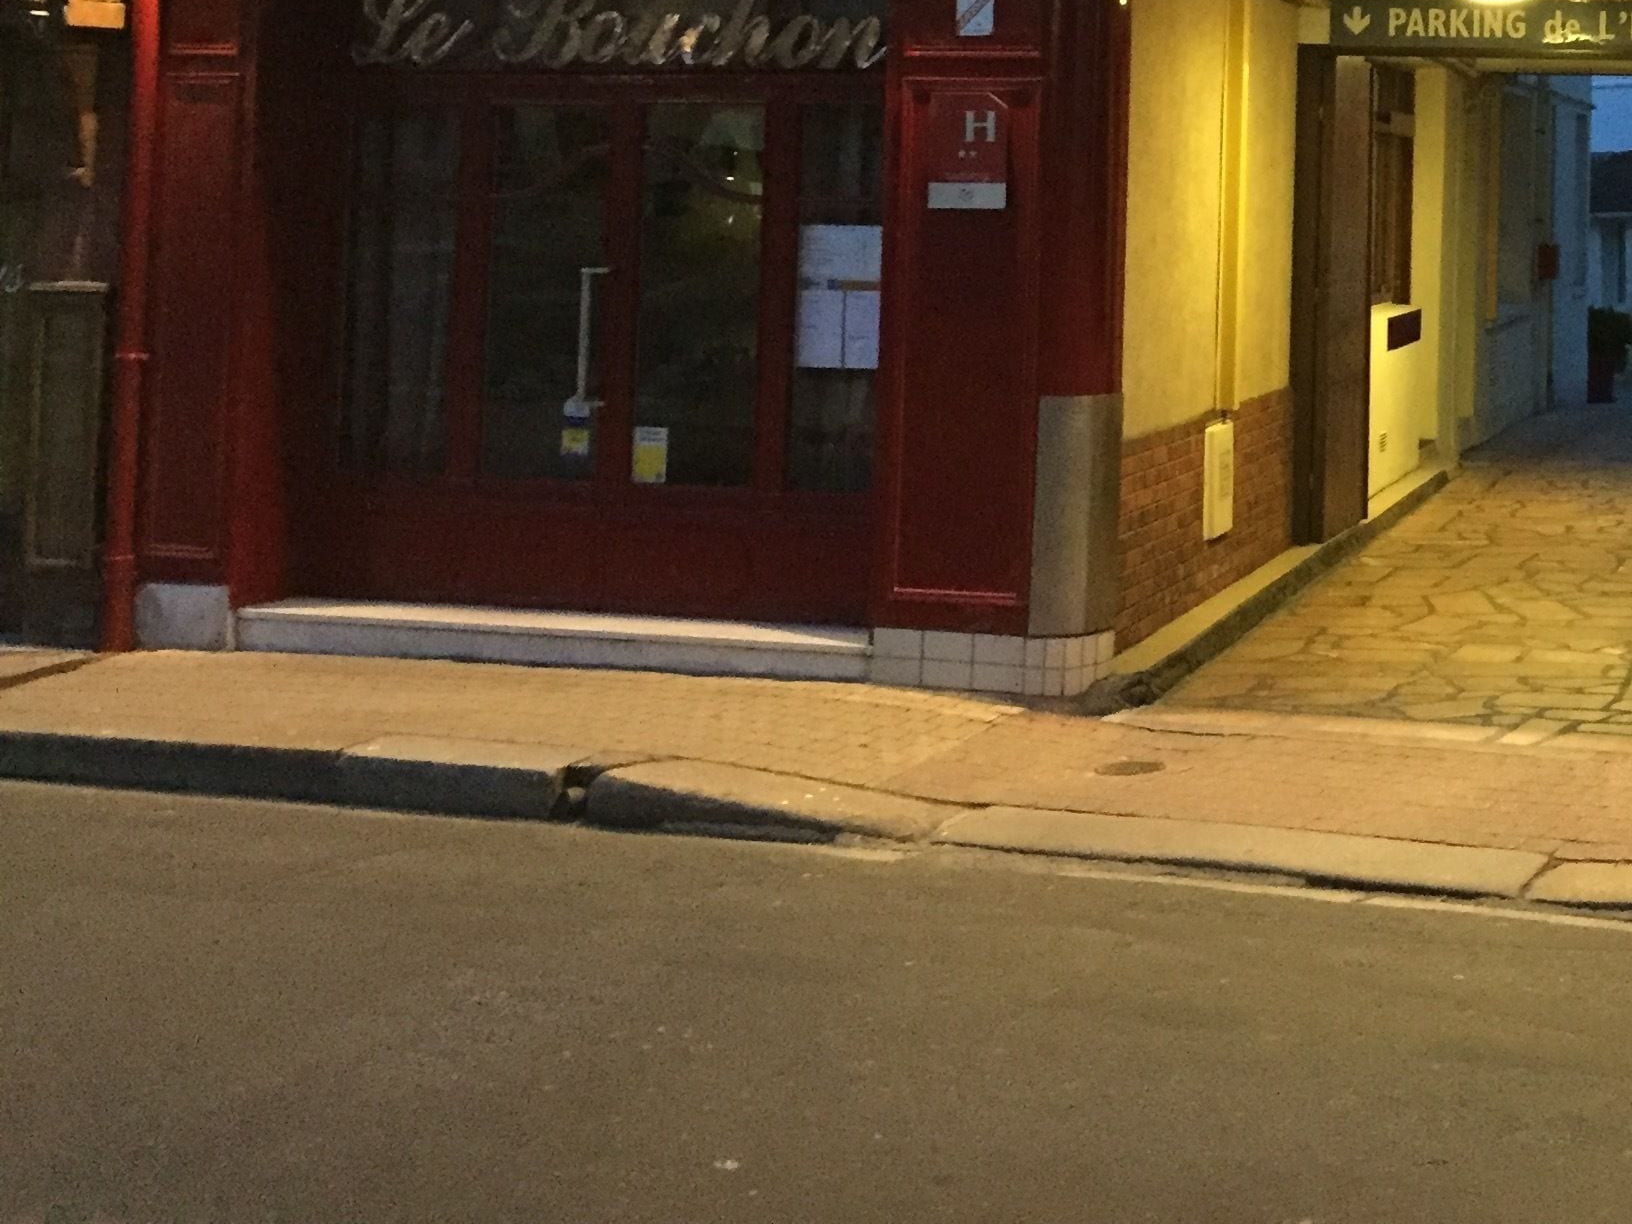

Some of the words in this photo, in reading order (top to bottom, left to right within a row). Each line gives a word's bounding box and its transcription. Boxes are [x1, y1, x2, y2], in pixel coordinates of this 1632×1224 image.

[1388, 7, 1527, 39] PARKING
[1543, 9, 1581, 43] de
[964, 110, 996, 143] H
